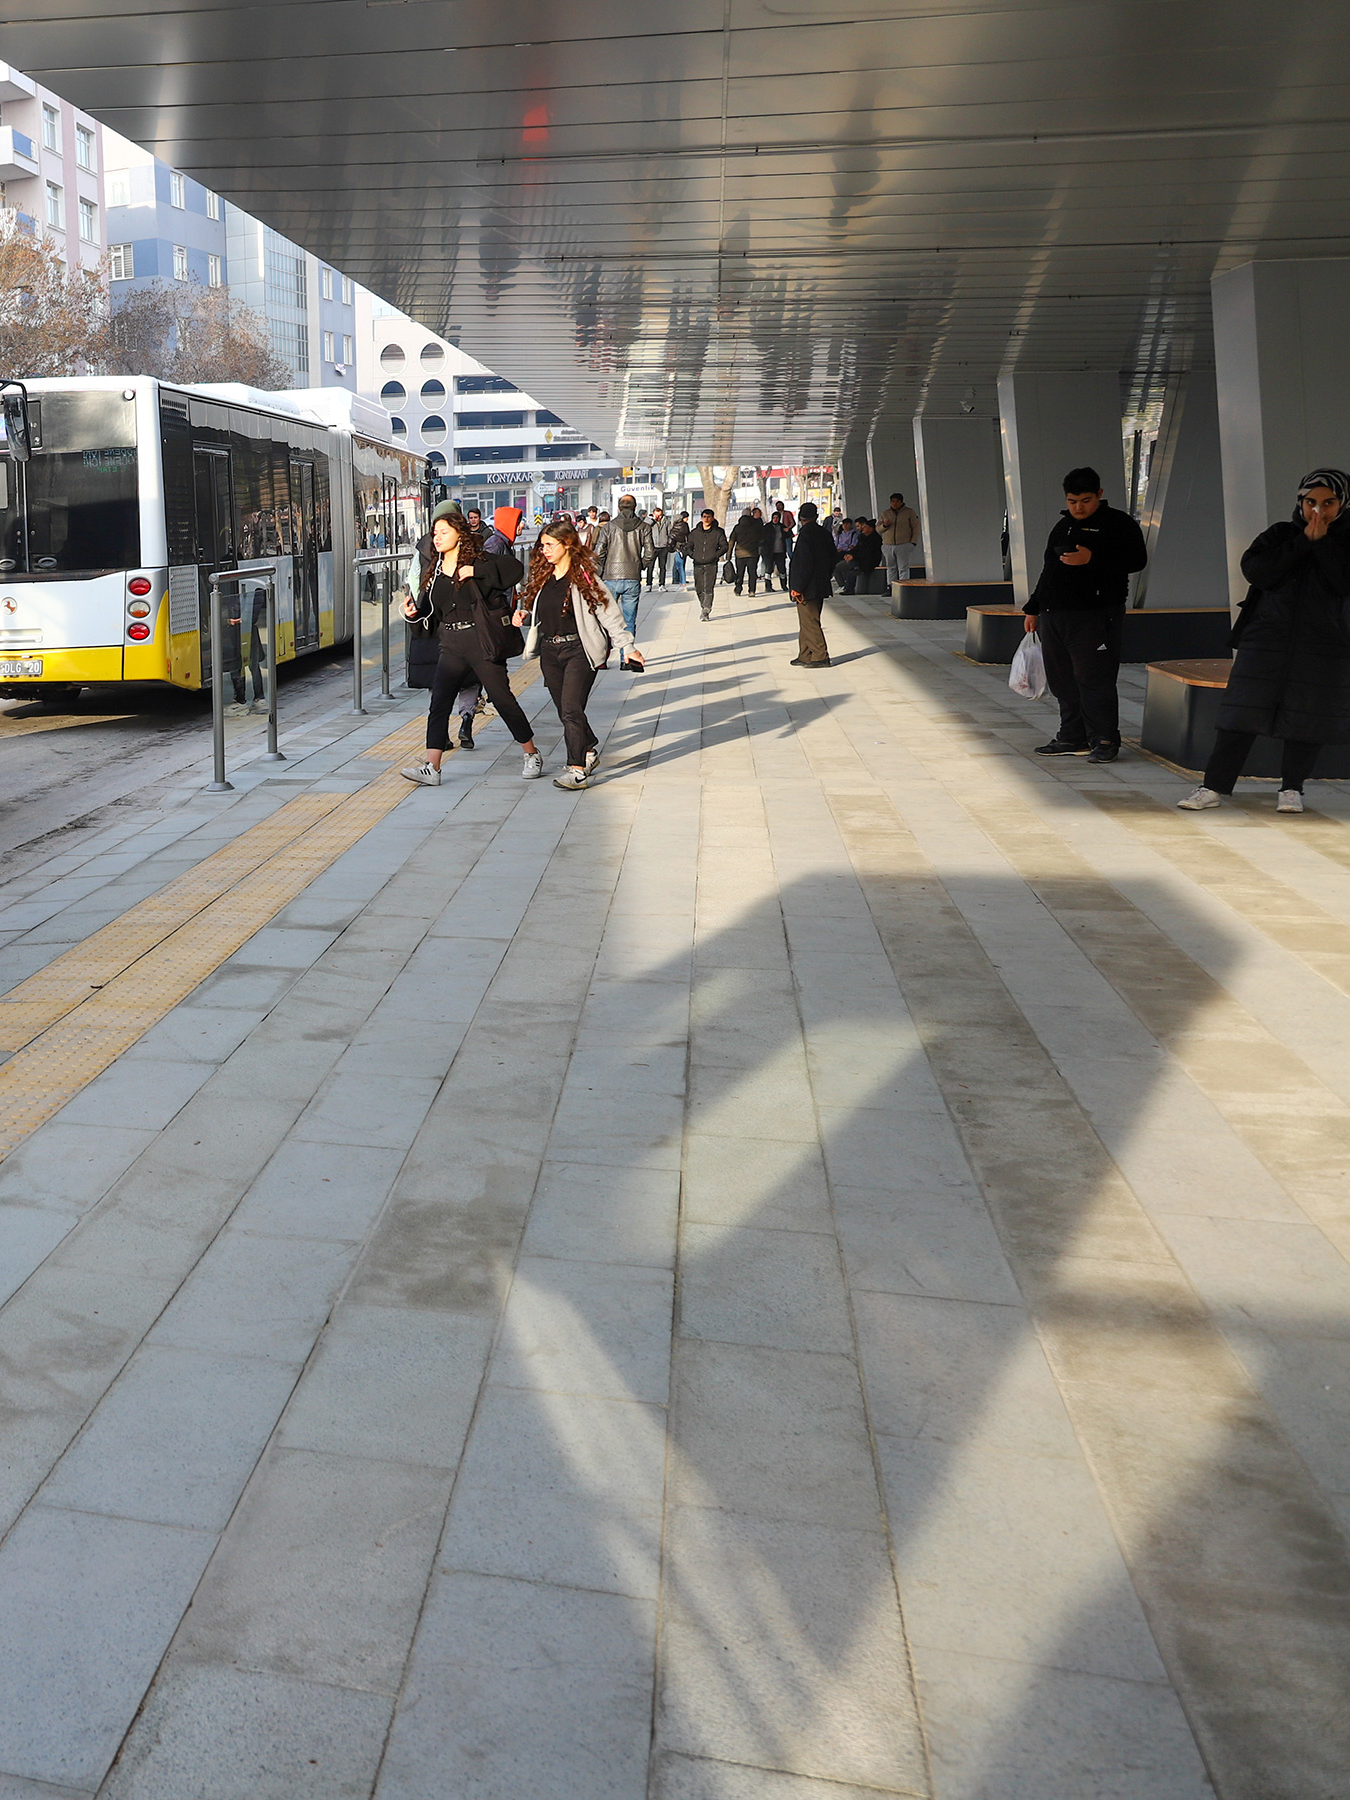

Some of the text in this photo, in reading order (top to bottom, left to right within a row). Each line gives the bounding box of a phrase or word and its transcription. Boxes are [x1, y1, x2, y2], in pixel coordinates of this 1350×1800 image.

[487, 469, 589, 484] KONYAKAR KONYAKART
[620, 485, 655, 493] Güvenlik
[28, 662, 40, 673] 20
